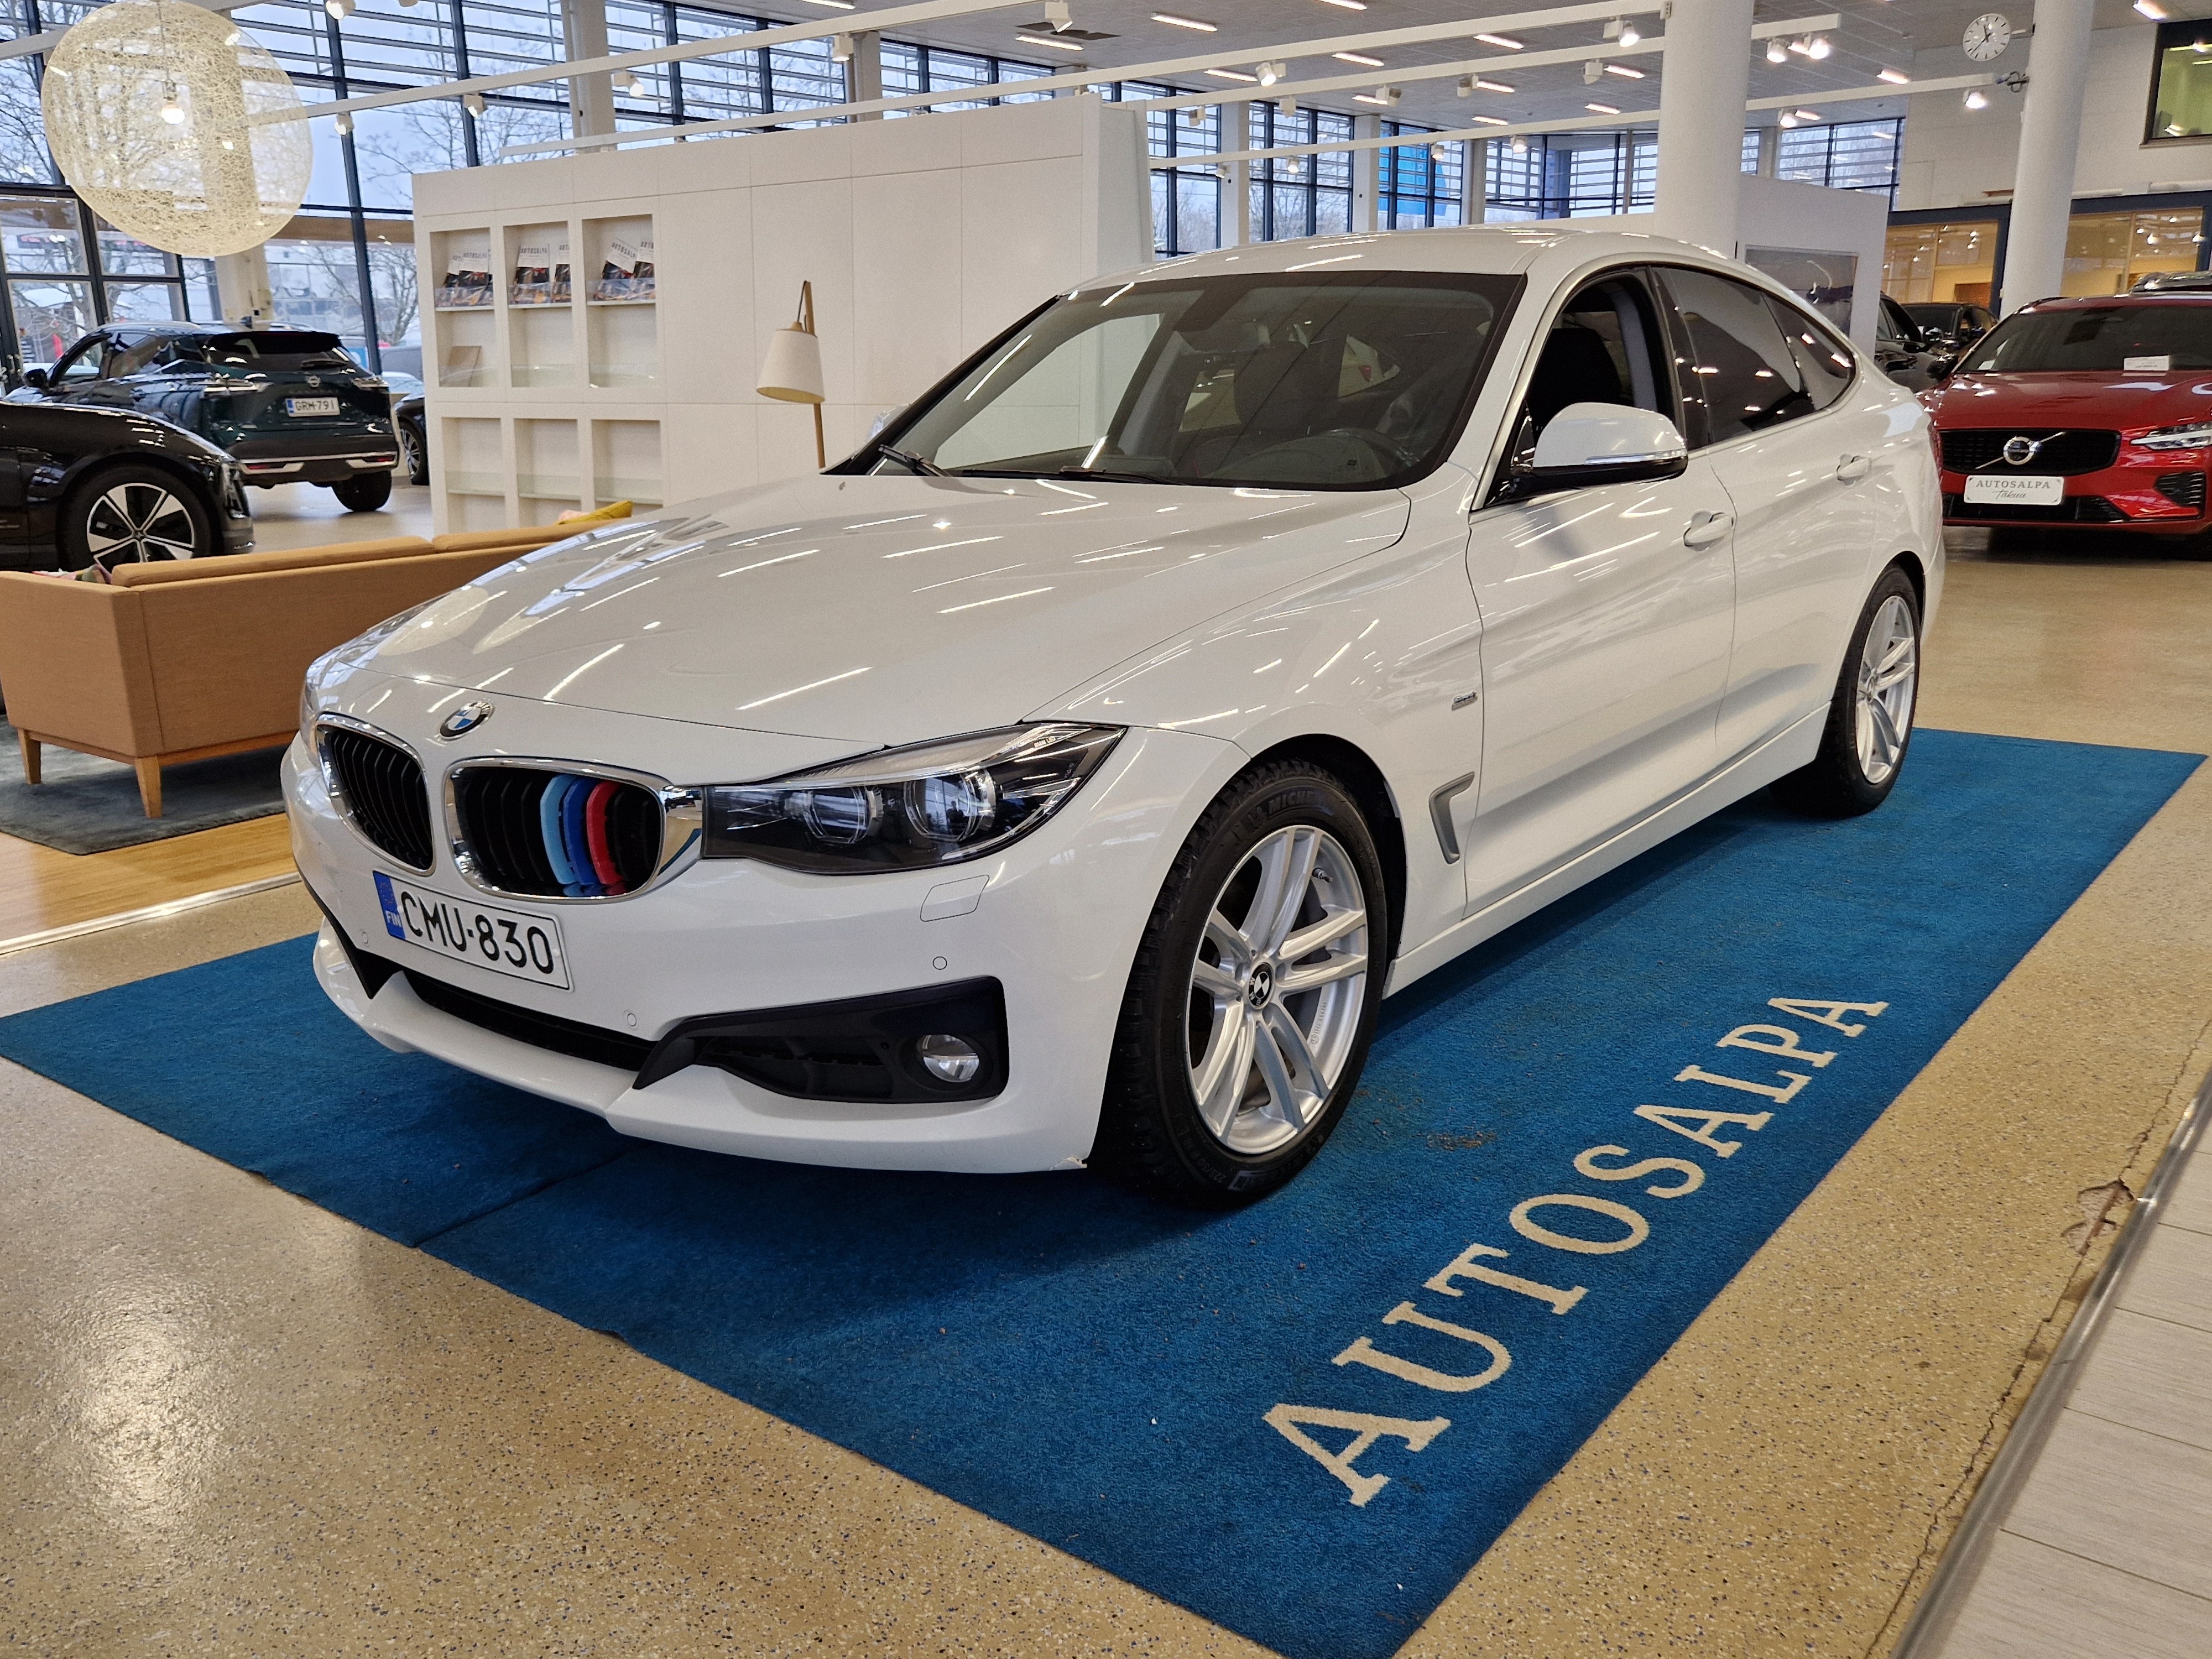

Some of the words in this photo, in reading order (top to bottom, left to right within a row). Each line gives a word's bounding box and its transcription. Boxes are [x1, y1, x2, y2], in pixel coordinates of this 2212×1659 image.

[1976, 480, 2051, 489] AUTOSALPA
[385, 910, 403, 928] FIN
[401, 891, 554, 974] CMU-830
[1264, 997, 1888, 1506] AUTOSALPA
